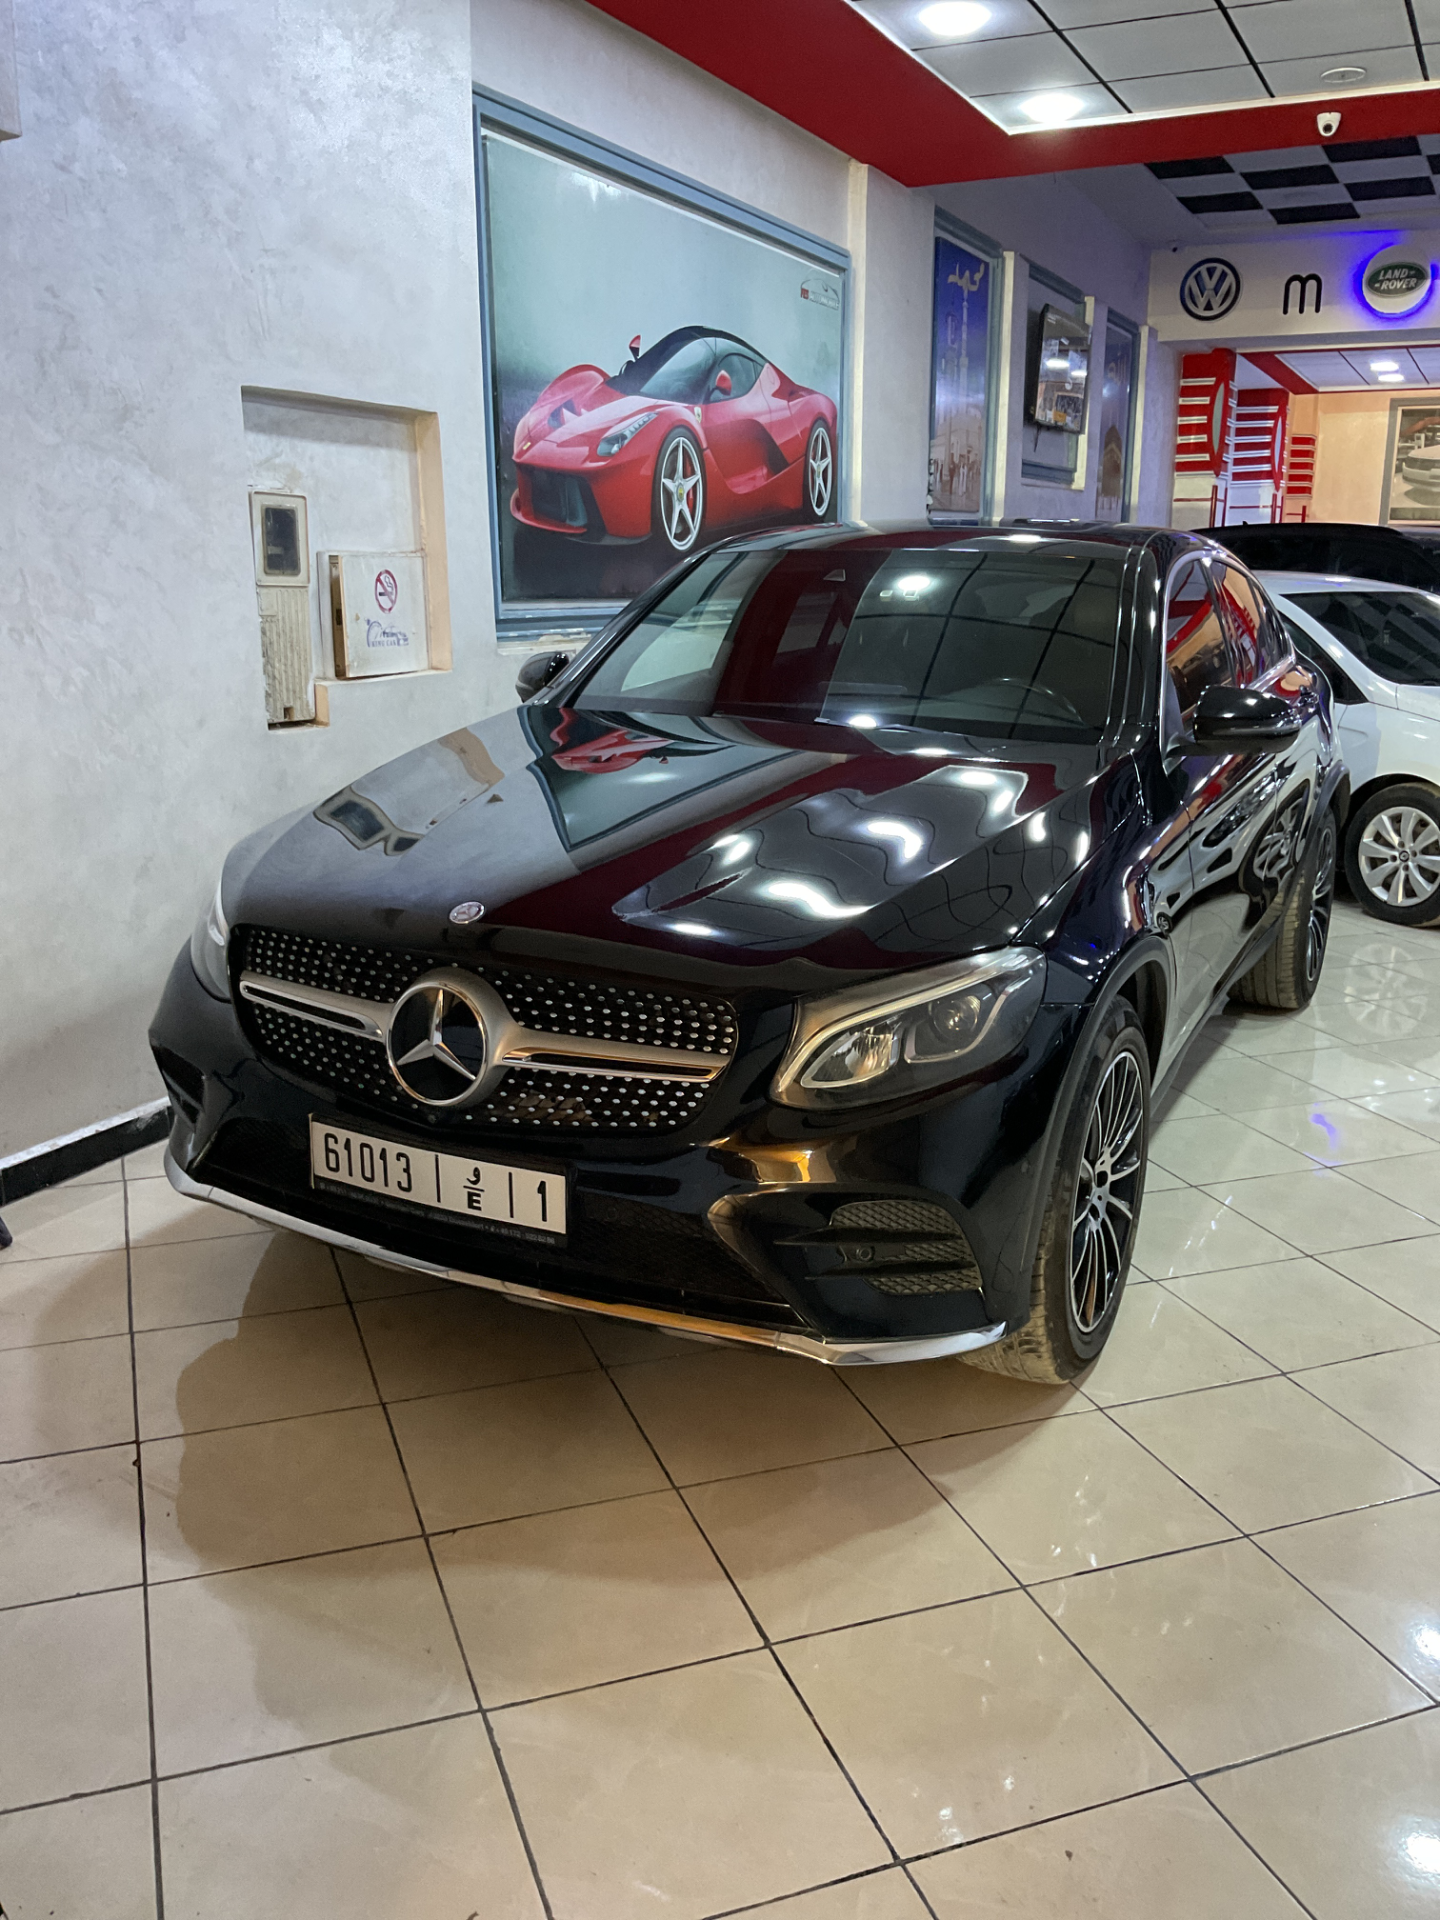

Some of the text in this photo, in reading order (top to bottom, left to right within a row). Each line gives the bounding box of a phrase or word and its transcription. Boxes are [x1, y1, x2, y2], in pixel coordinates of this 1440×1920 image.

[1380, 277, 1418, 291] ROVER
[324, 1132, 413, 1193] 61013
[467, 1191, 482, 1212] E
[537, 1180, 548, 1222] 1
